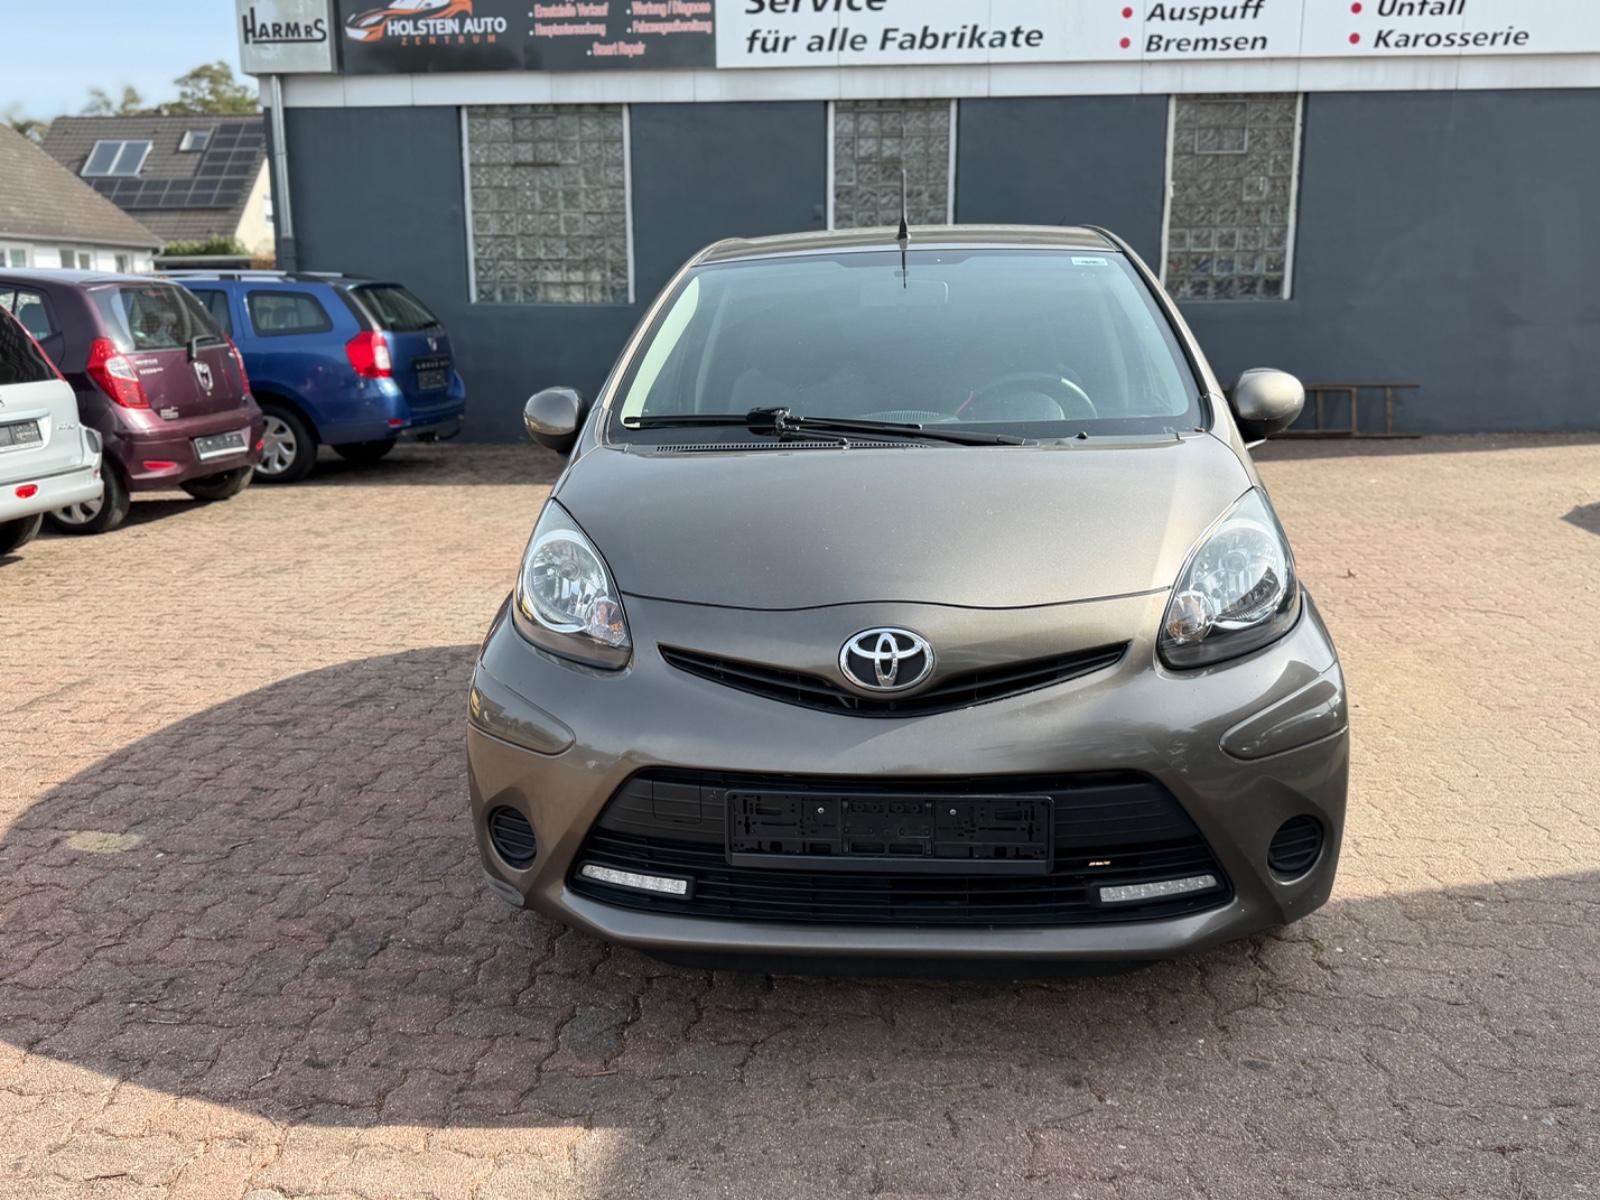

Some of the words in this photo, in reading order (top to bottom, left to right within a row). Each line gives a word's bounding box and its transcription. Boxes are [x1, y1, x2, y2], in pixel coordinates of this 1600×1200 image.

[1146, 0, 1265, 26] Auspuff
[1377, 0, 1466, 17] Unfall
[387, 18, 459, 36] HOLSTEIN
[463, 16, 507, 34] AUTO
[401, 34, 496, 46] ZENTRUM
[746, 29, 797, 53] für
[806, 27, 868, 52] alle
[879, 24, 1044, 51] Fabrikate
[1145, 34, 1268, 53] Bremsen
[1373, 25, 1530, 49] Karosserie
